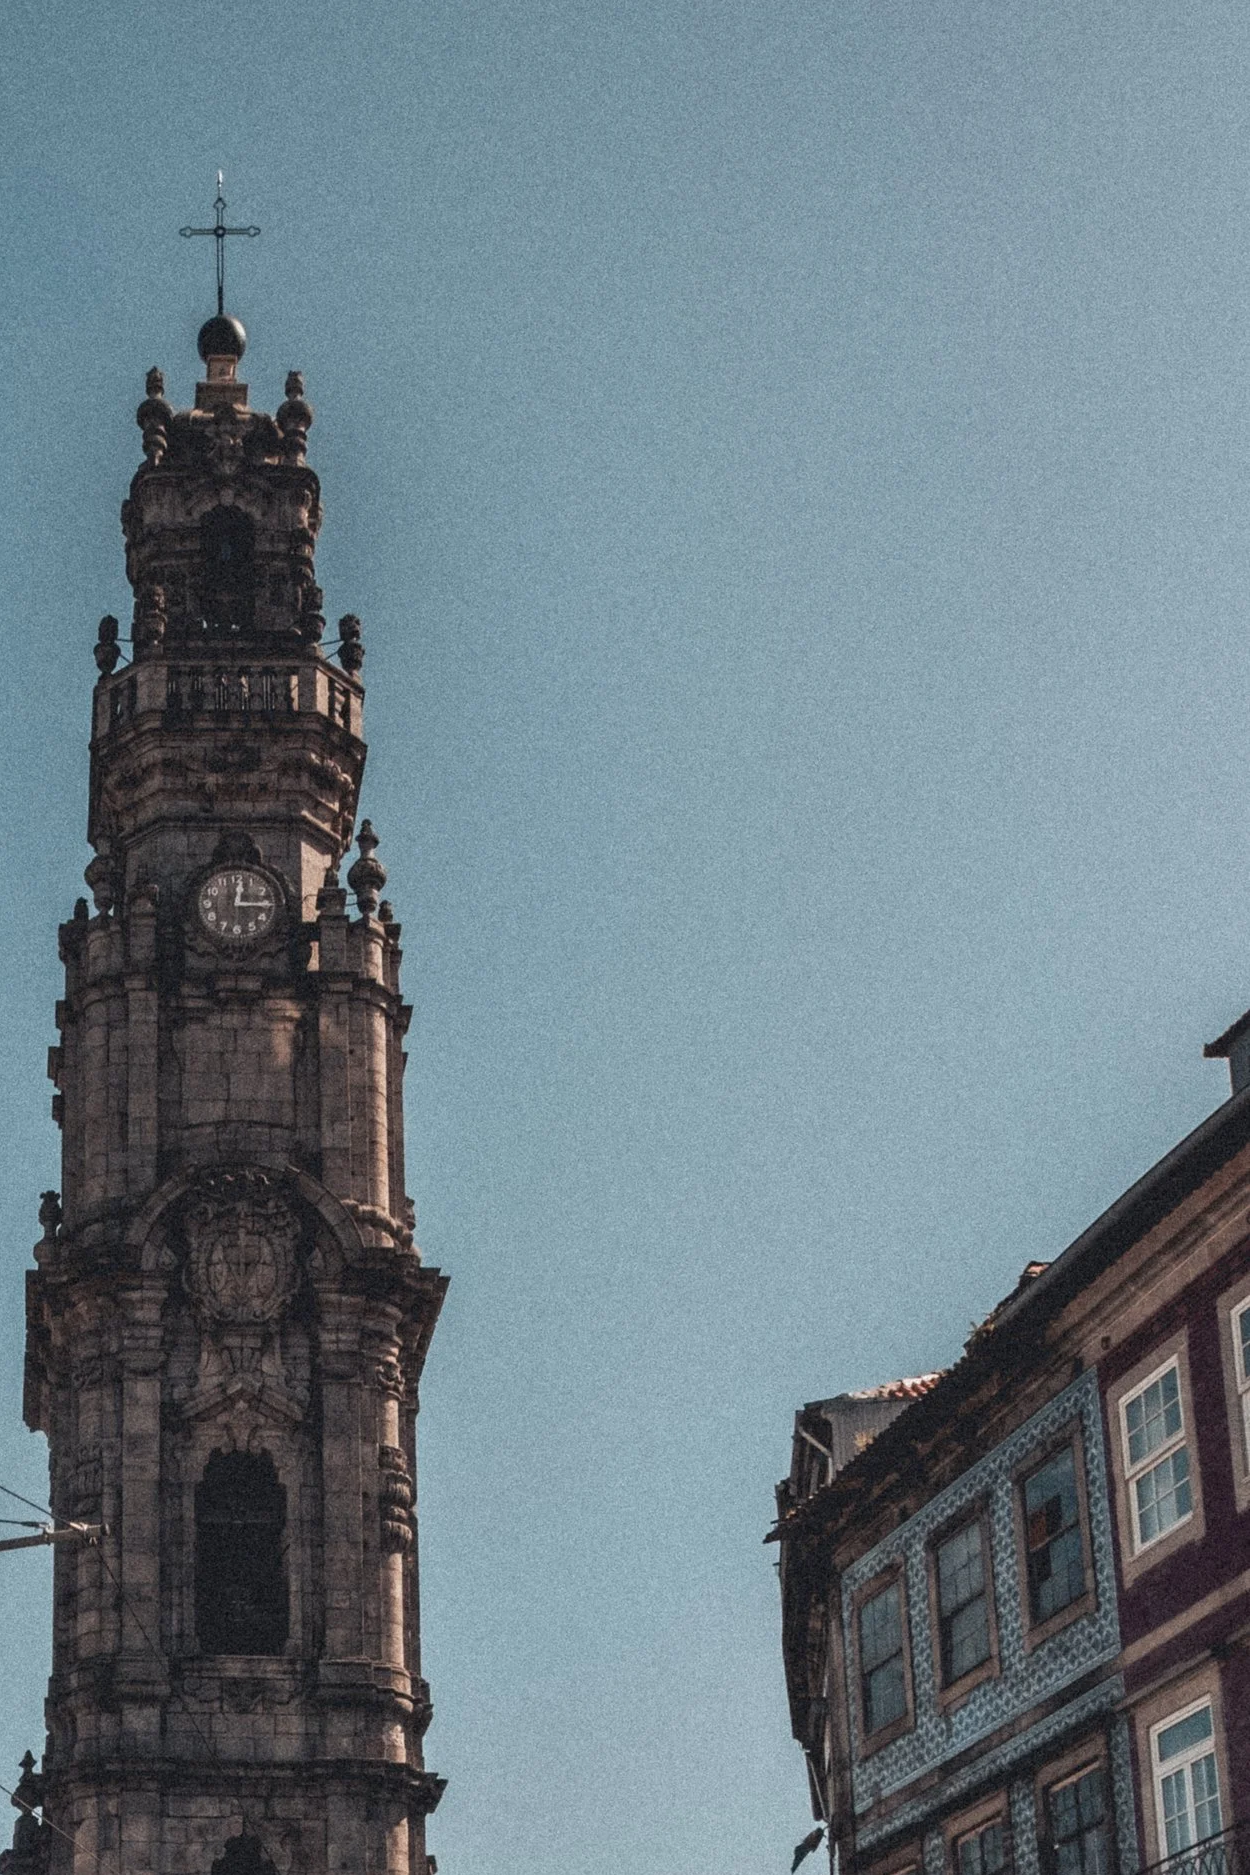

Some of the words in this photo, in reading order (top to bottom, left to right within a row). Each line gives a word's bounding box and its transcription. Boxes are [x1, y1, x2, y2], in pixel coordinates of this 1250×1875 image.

[207, 887, 219, 896] 10
[258, 887, 266, 896] 2
[203, 900, 212, 909] 9
[207, 912, 216, 921] 8
[257, 913, 266, 922] 4
[220, 921, 227, 931] 7
[233, 925, 242, 935] 6
[248, 922, 256, 931] 5
